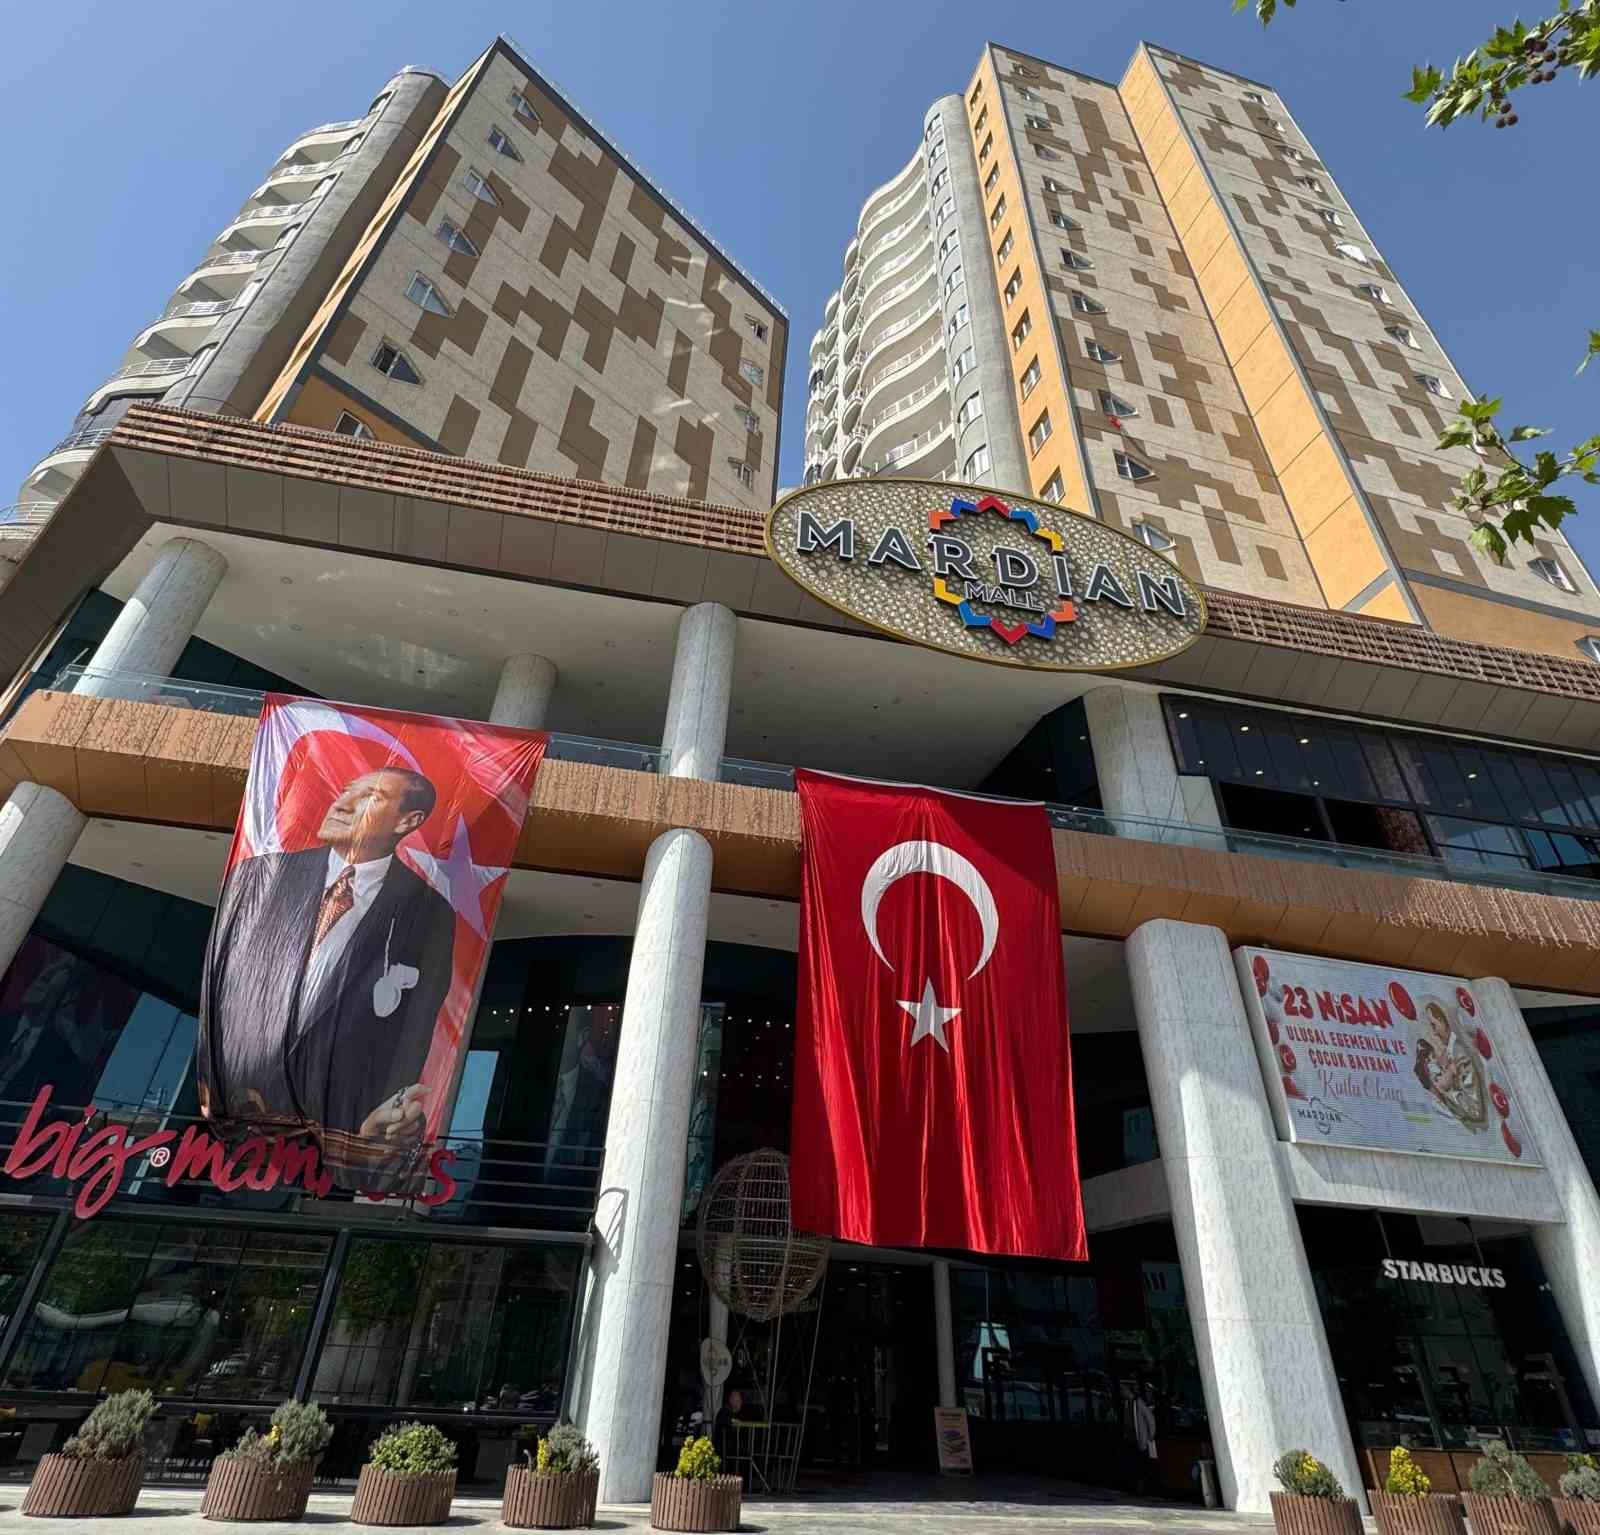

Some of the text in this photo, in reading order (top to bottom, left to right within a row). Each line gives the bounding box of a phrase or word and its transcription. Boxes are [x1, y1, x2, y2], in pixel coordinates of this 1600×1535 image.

[965, 581, 1045, 612] MALL
[1282, 984, 1313, 1019] 23
[1285, 1024, 1408, 1056] ULUSAL EGEMENLİK VE
[1308, 1047, 1399, 1074] ÇOCUK BAYRAMI
[5, 1084, 177, 1219] big
[1382, 1258, 1507, 1289] STARBUCKS
